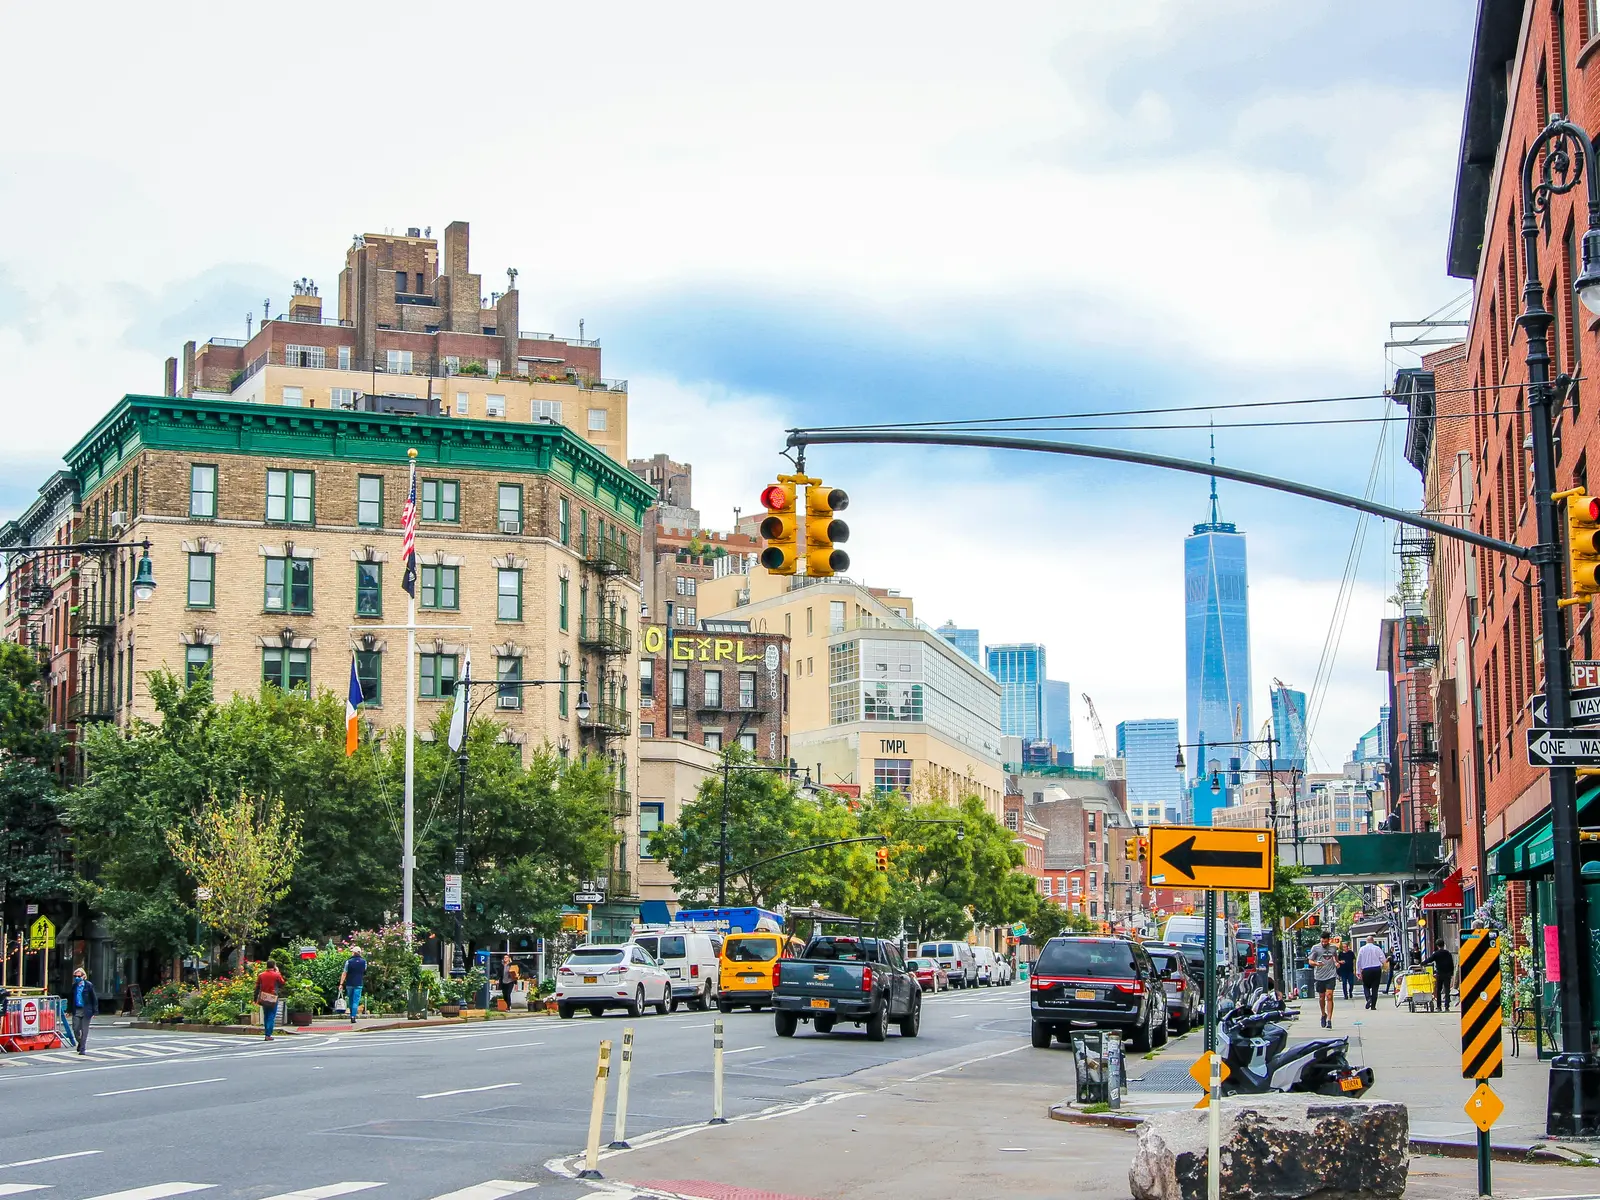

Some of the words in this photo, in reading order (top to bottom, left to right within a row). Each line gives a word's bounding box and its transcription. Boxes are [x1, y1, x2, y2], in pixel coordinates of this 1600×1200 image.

[880, 740, 908, 753] TMPL
[1540, 741, 1566, 754] ONE
[1580, 741, 1600, 754] WA
